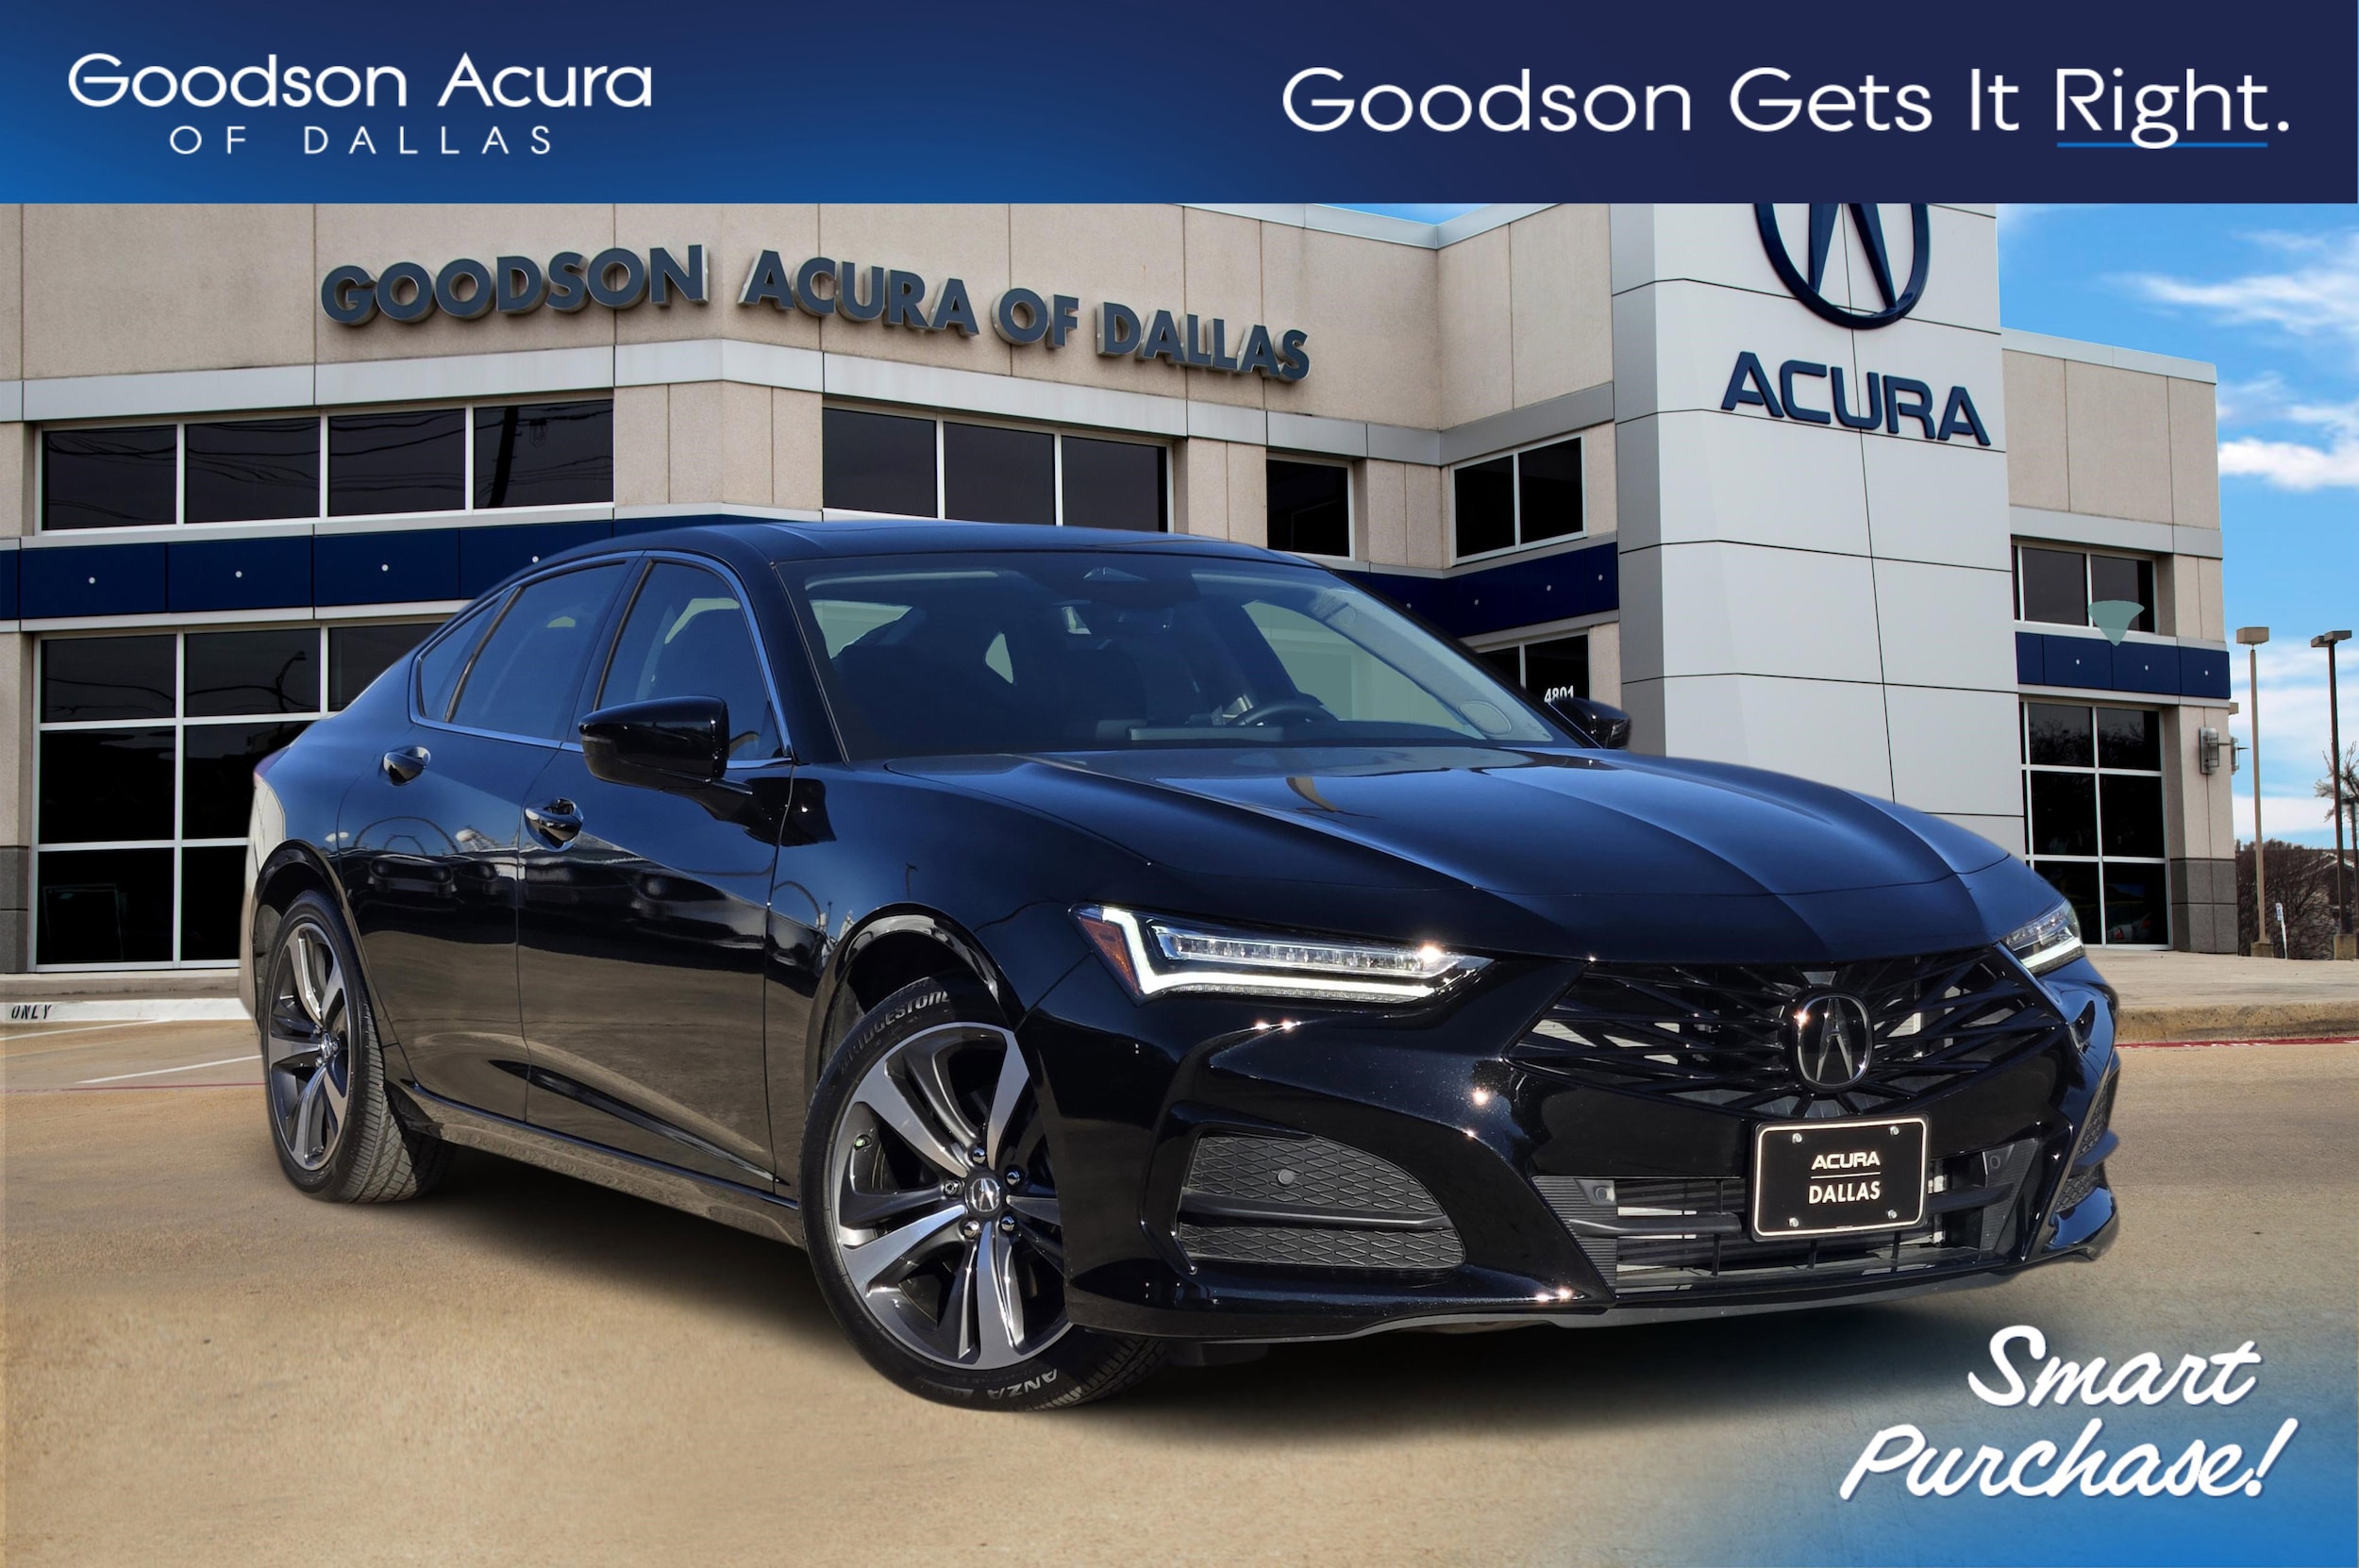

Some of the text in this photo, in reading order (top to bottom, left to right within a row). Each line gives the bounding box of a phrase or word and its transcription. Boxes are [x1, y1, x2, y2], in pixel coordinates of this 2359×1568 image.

[321, 244, 1311, 382] GOODSON ACURA OF DALLAS
[1720, 350, 1991, 447] ACURA
[1544, 685, 1574, 704] 4801
[11, 1004, 53, 1020] ONLY
[1811, 1150, 1881, 1171] ACURA
[1808, 1180, 1882, 1205] DALLAS
